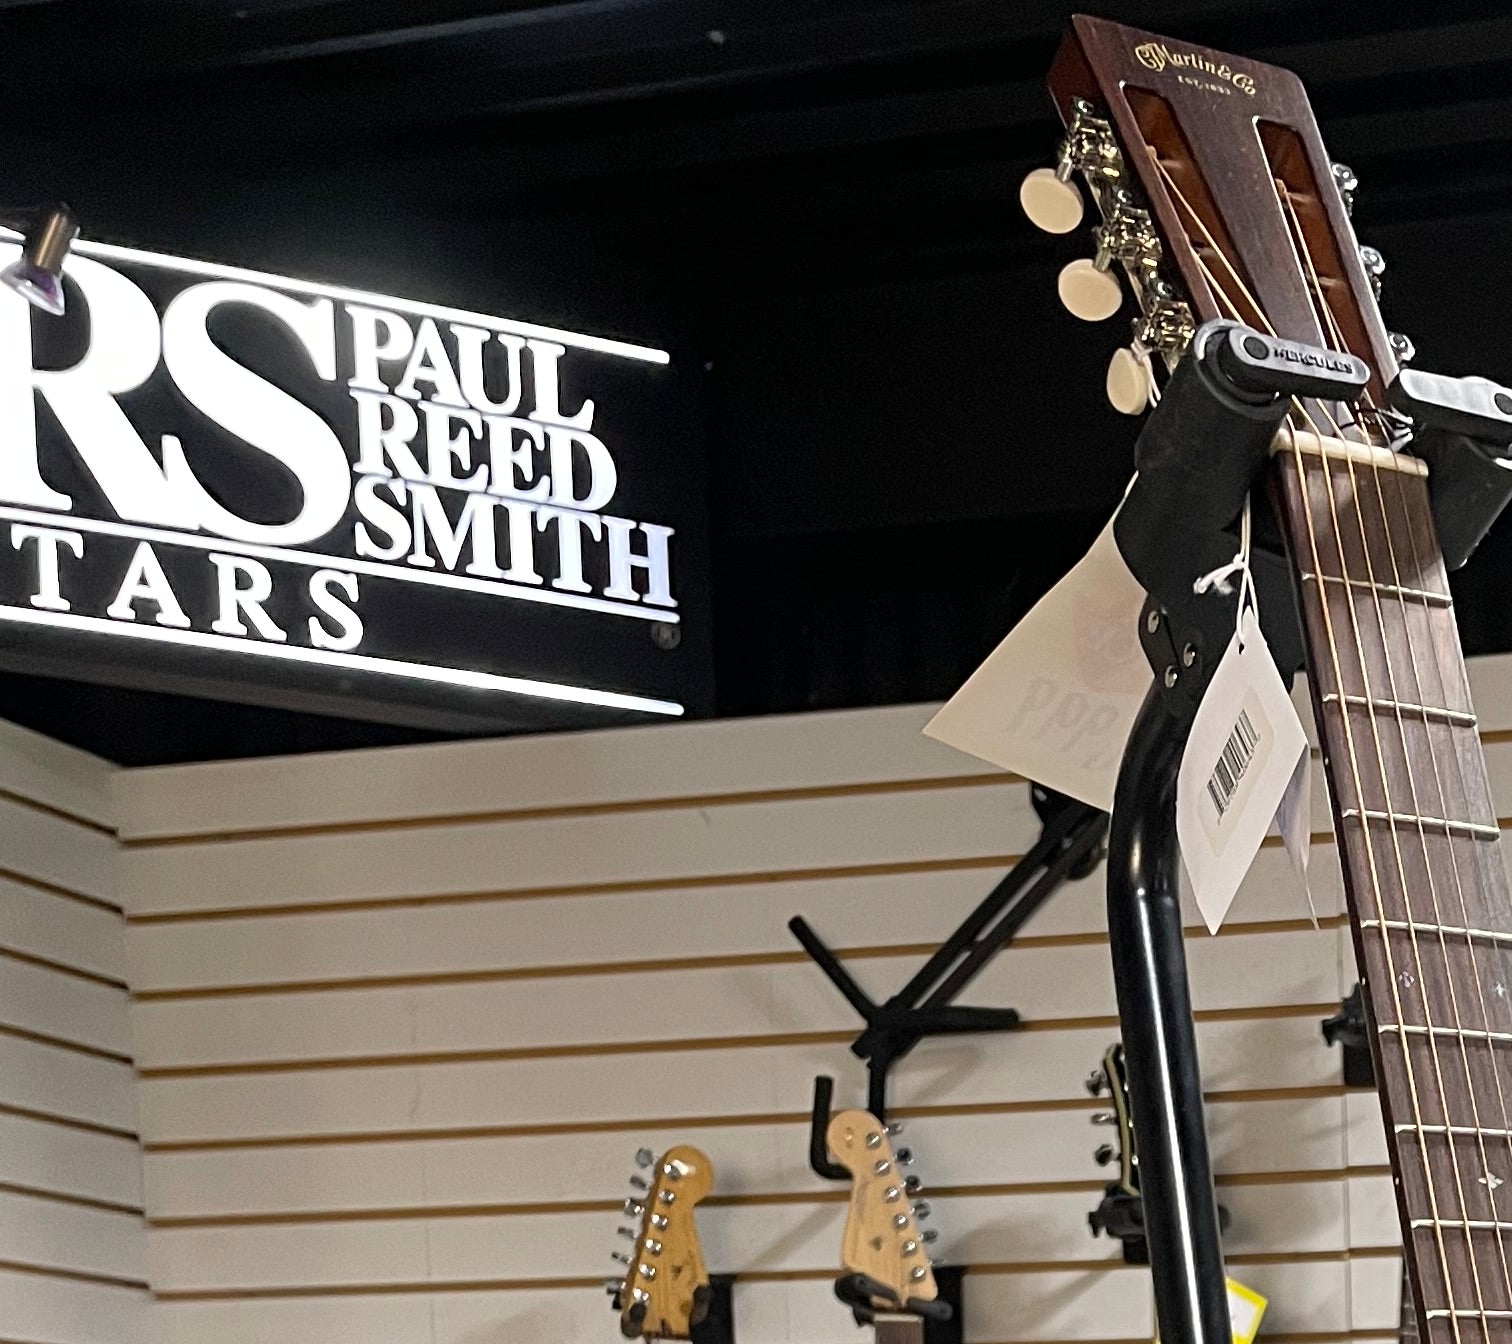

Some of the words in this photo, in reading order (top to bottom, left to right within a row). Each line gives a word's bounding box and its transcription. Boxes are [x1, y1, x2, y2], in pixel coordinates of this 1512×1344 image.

[344, 301, 596, 432] PAUL
[350, 388, 619, 512] REED
[11, 523, 367, 652] TARS
[353, 476, 679, 608] SMITH
